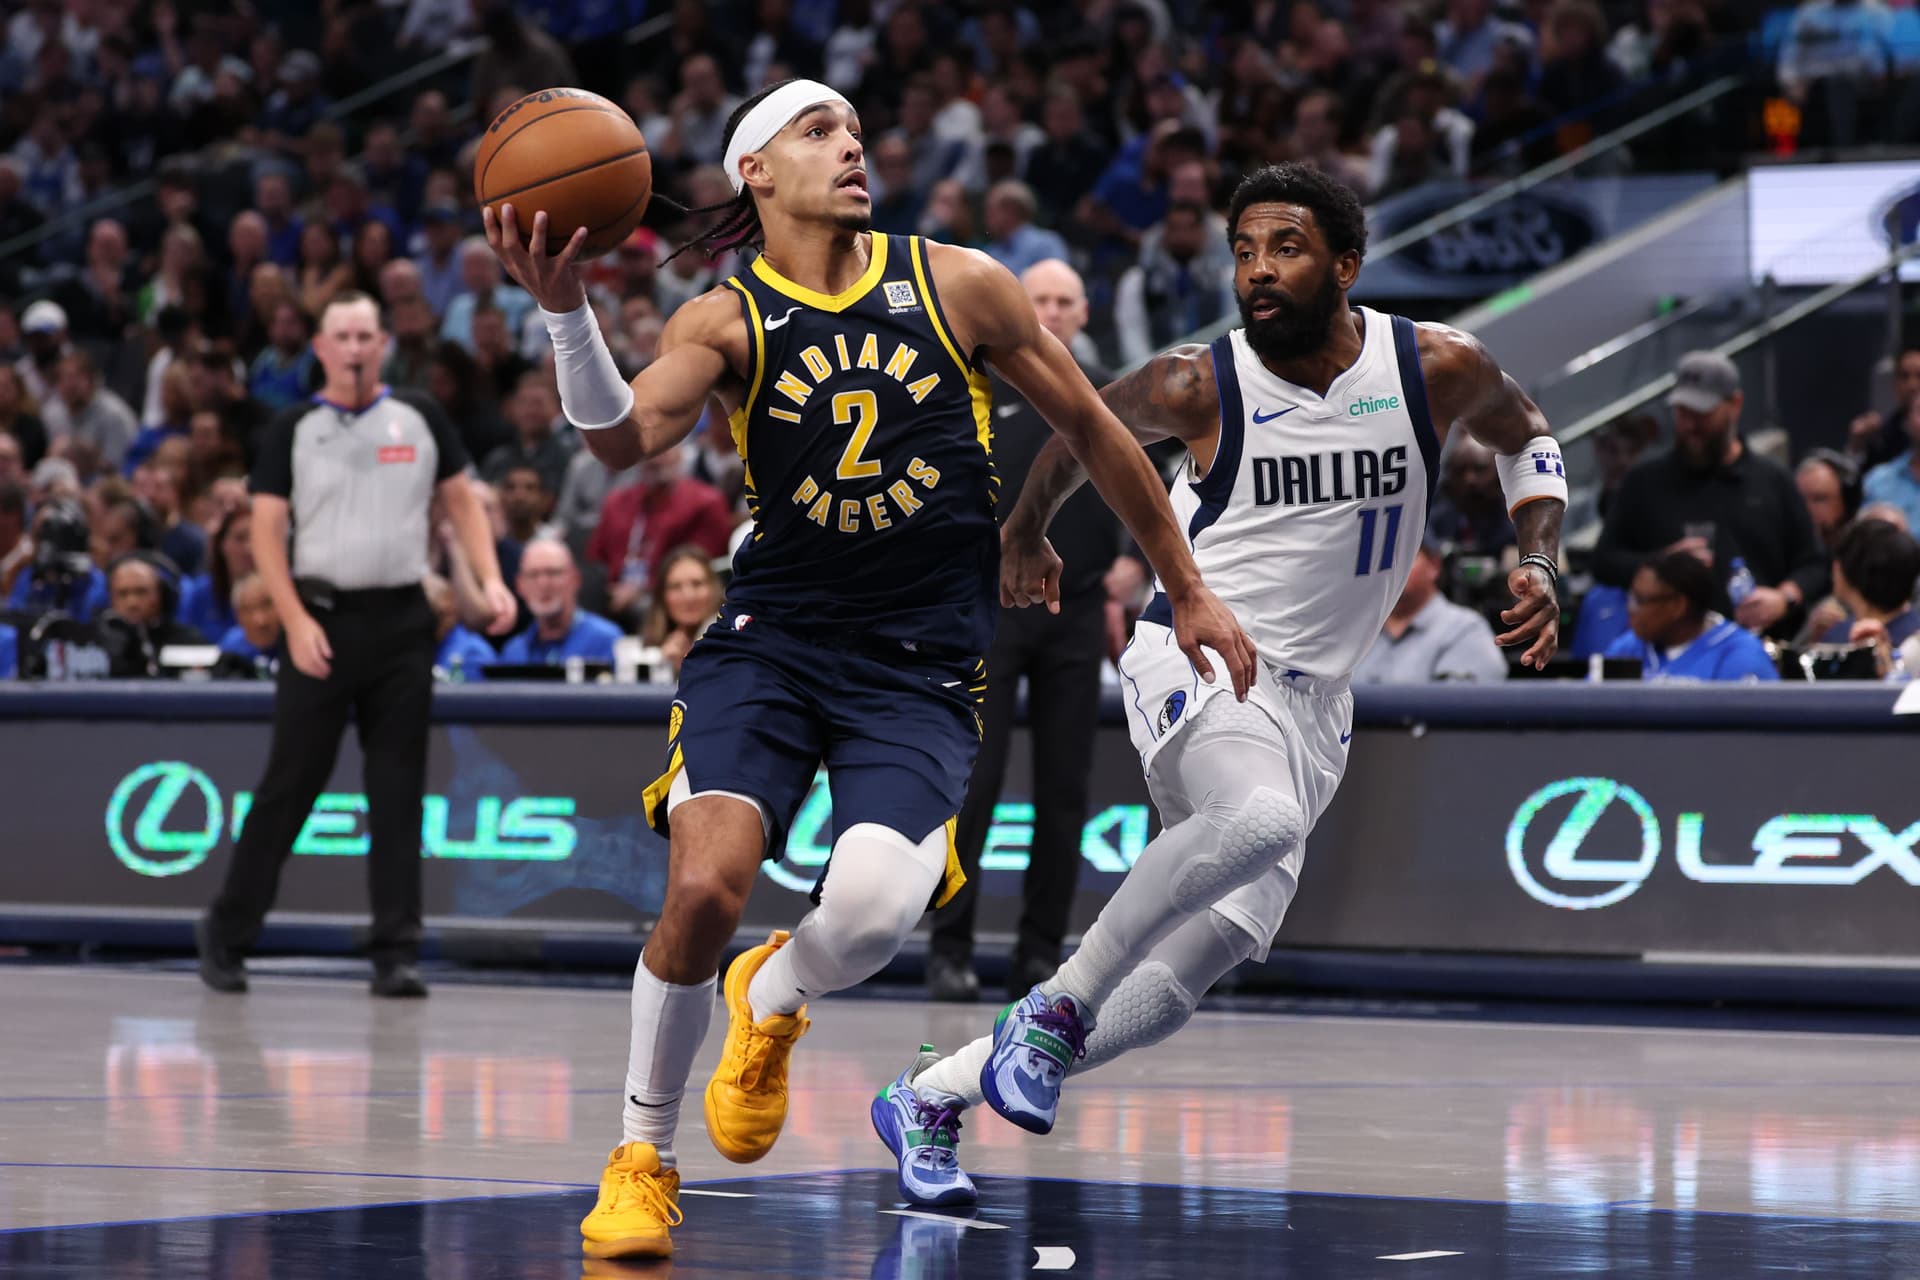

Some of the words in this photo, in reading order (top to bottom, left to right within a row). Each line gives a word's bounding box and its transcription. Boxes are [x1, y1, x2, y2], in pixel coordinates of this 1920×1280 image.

[769, 333, 941, 424] INDIANA
[1350, 396, 1400, 416] chime
[832, 389, 882, 480] 2
[791, 457, 941, 533] PACERS
[1252, 445, 1409, 508] DALLAS
[1355, 504, 1403, 577] 11
[231, 792, 578, 861] EUS
